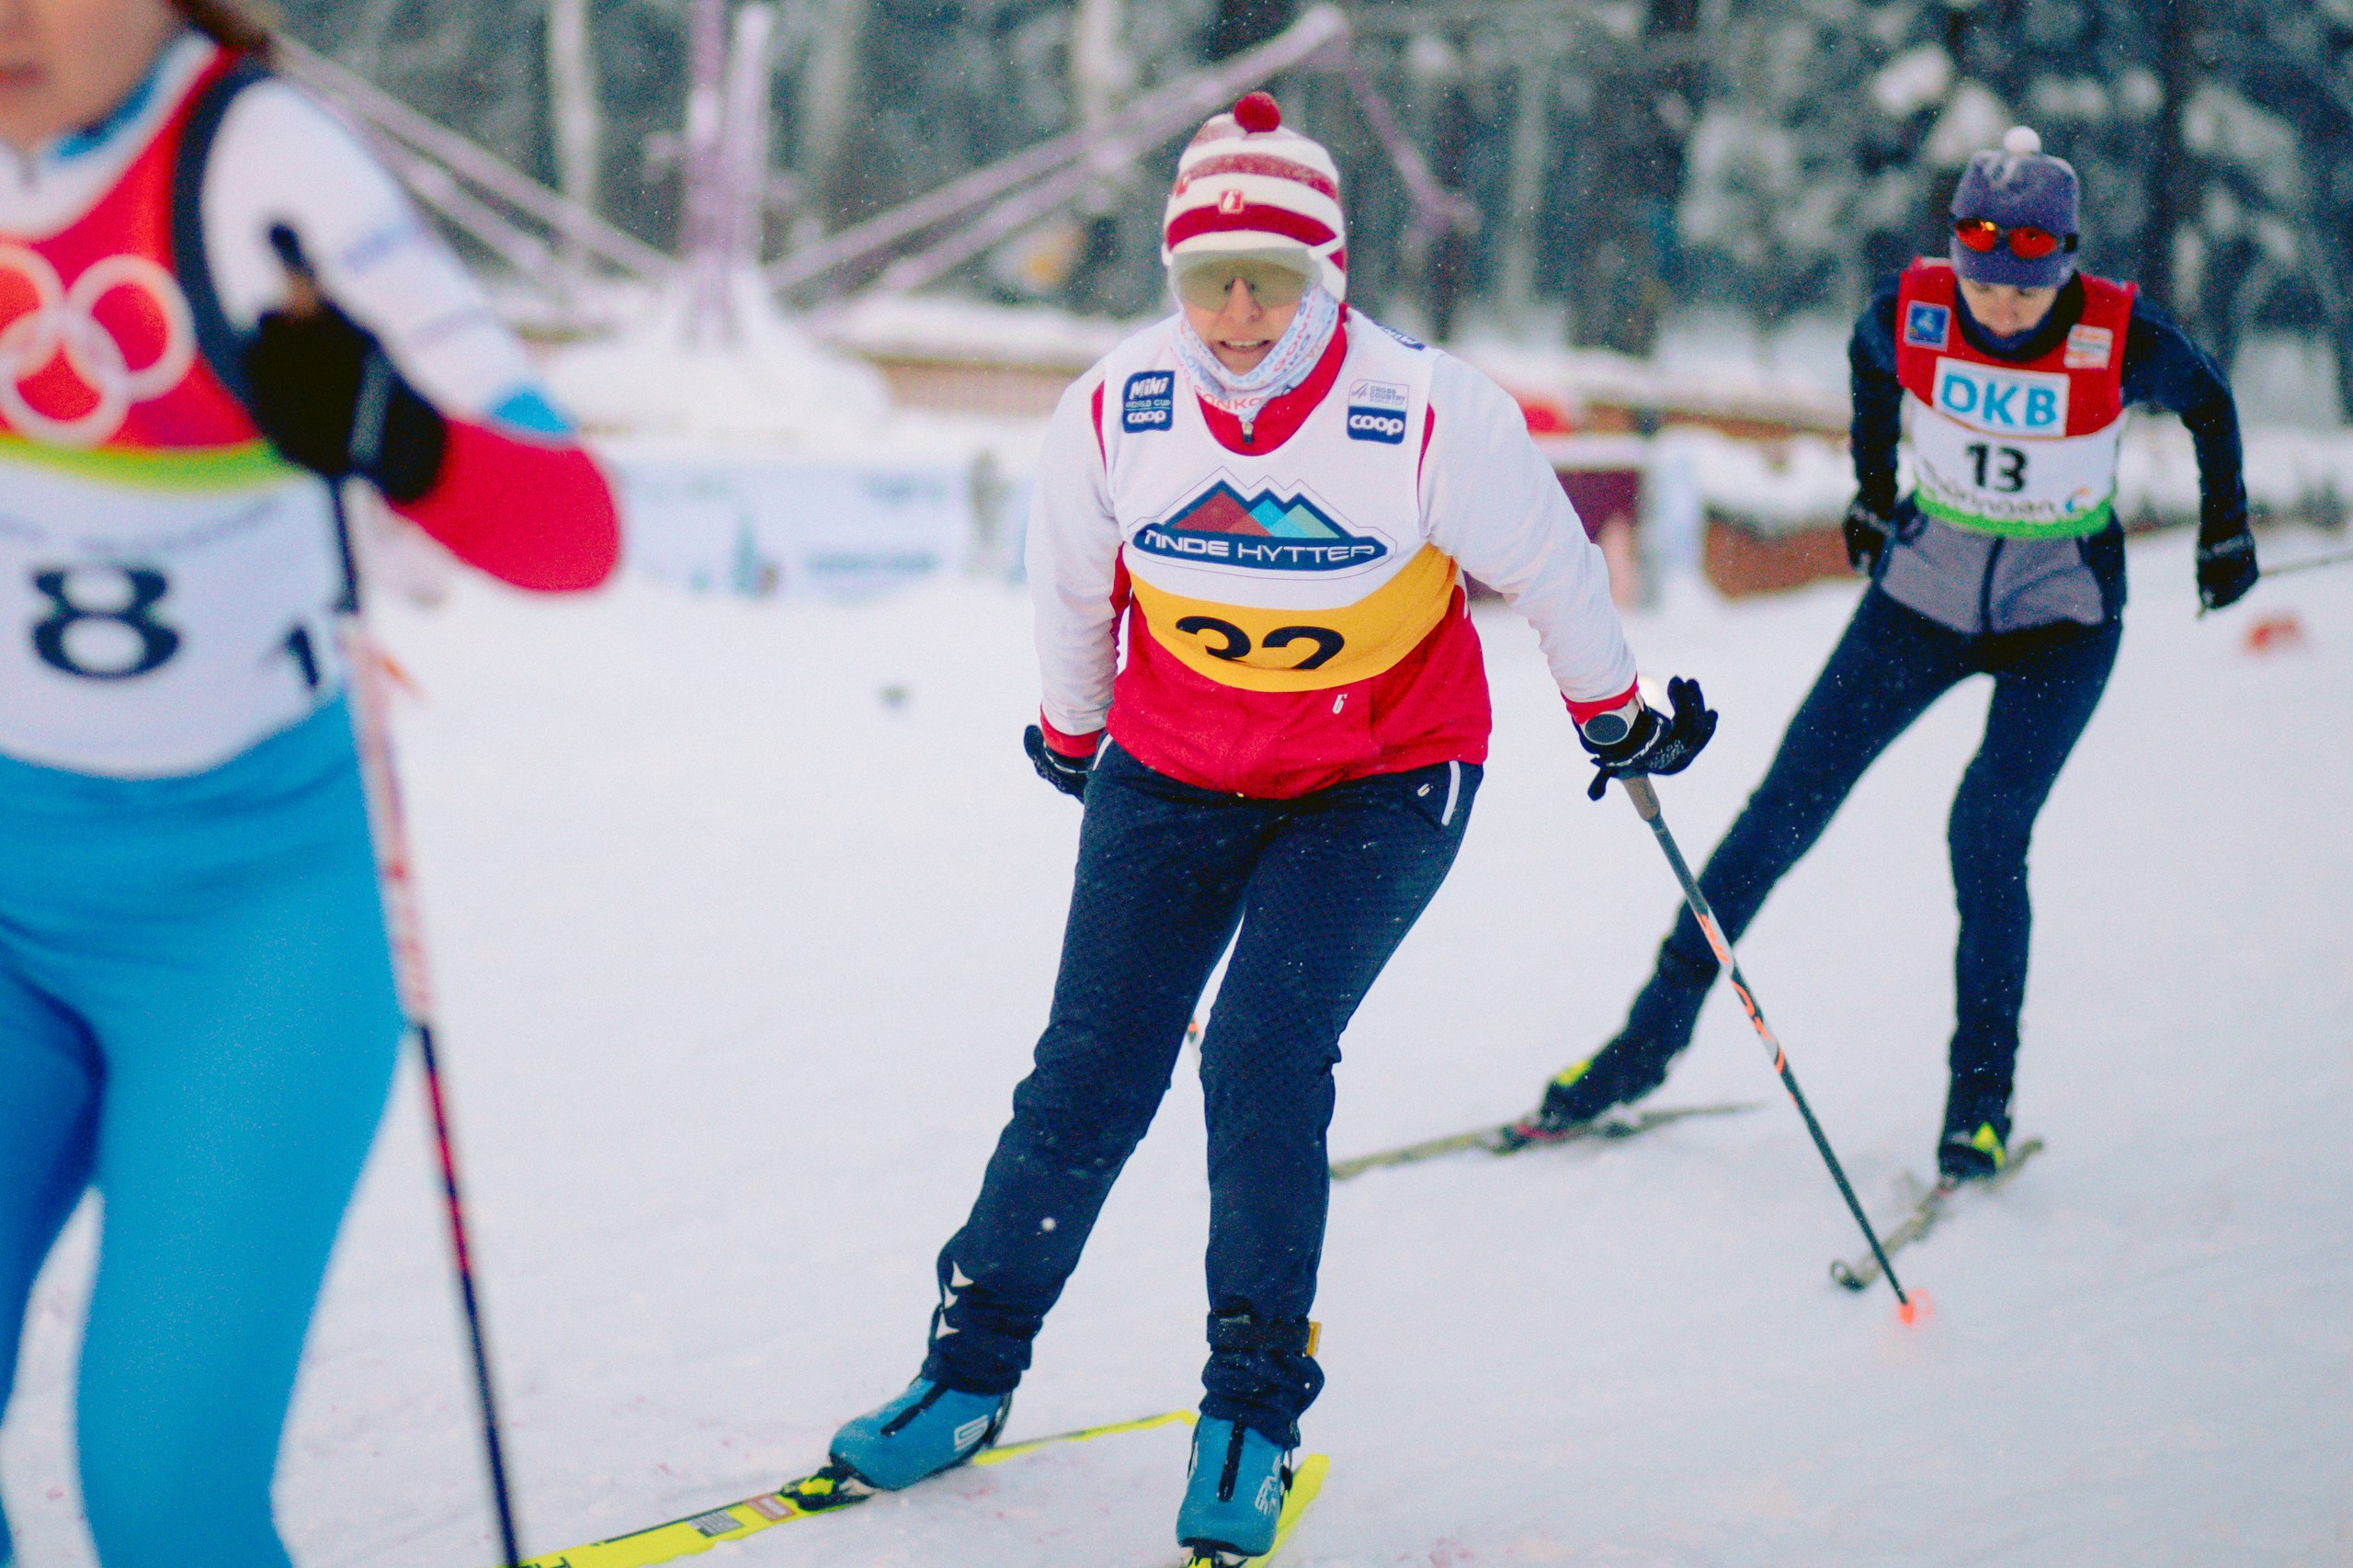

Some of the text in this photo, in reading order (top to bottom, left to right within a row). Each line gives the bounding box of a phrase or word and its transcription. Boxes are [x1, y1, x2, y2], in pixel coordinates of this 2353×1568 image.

[1127, 410, 1166, 424] coop
[1942, 374, 2057, 426] DKB
[1349, 415, 1404, 436] coop
[1966, 444, 2028, 493] 13
[1143, 529, 1230, 557] TINDE
[31, 562, 184, 682] 8
